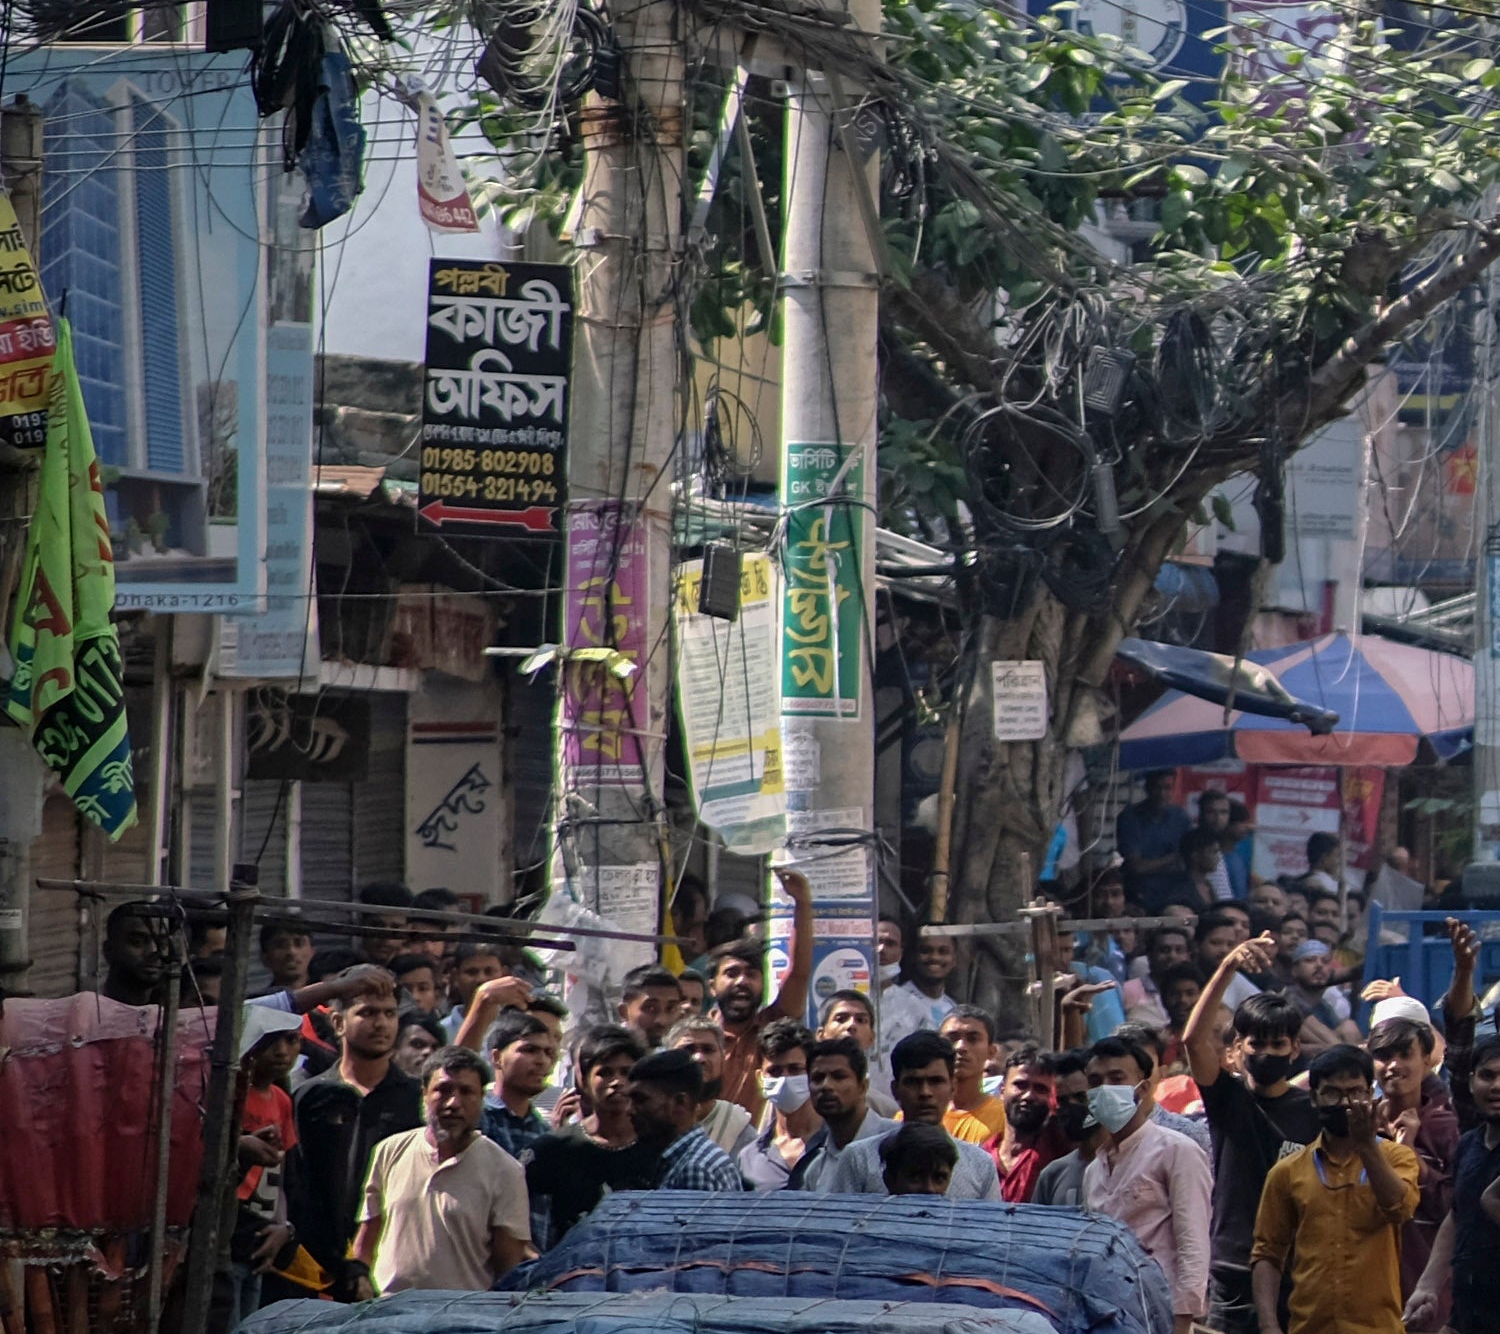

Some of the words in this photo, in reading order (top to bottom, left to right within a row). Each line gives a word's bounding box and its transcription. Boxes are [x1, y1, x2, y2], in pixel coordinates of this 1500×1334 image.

[434, 264, 510, 296] পল্লবী
[429, 278, 570, 353] কাজী
[427, 349, 567, 424] অফিস
[423, 447, 555, 476] 01985-802908
[421, 472, 558, 502] 01554-321494
[791, 480, 811, 494] GK
